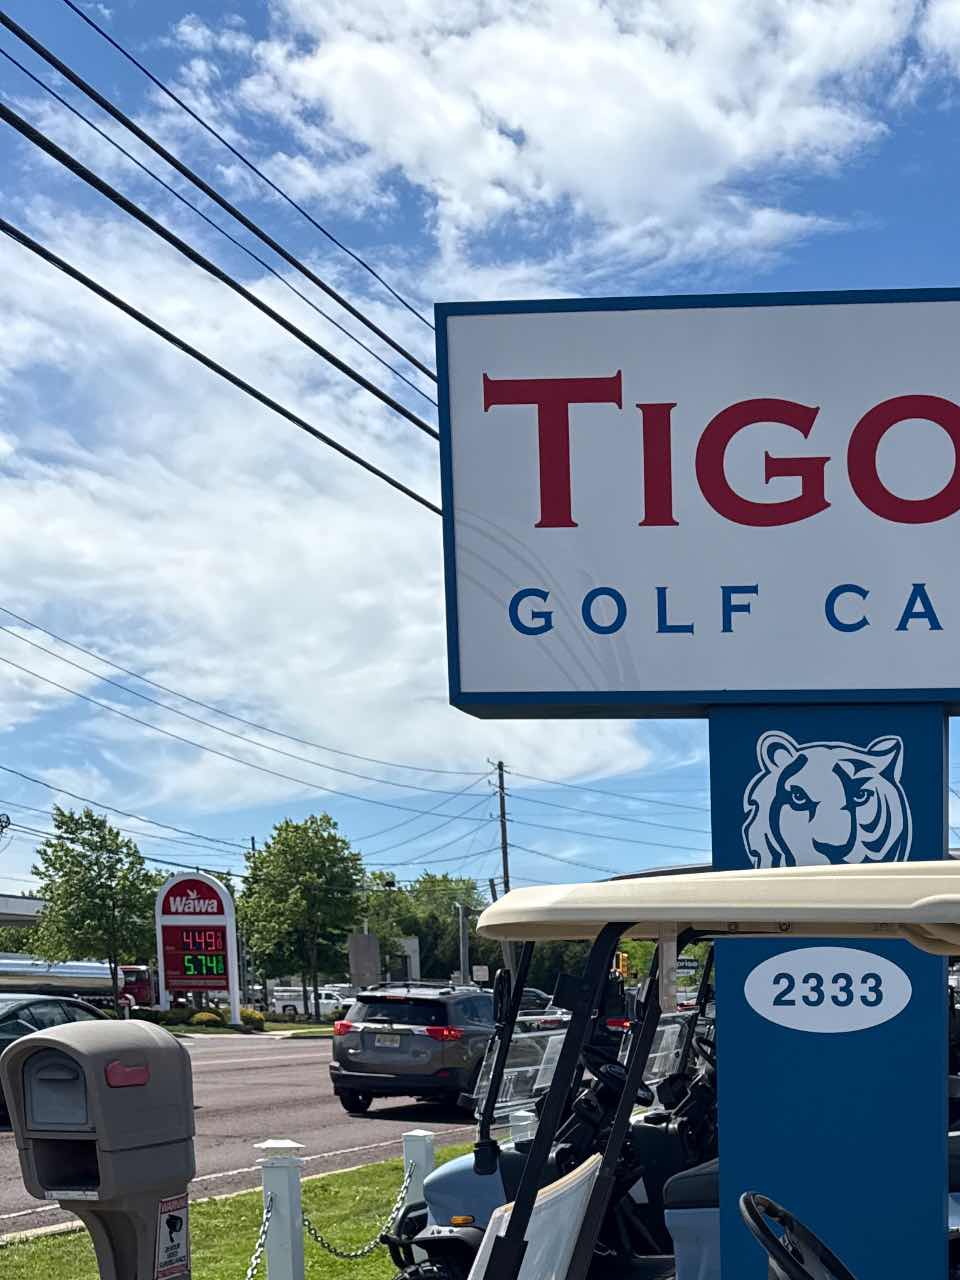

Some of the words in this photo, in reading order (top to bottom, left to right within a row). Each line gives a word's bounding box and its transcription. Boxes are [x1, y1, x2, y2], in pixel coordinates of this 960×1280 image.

[508, 583, 759, 636] GOLF
[169, 896, 218, 913] Wawa
[772, 972, 884, 1007] 2333
